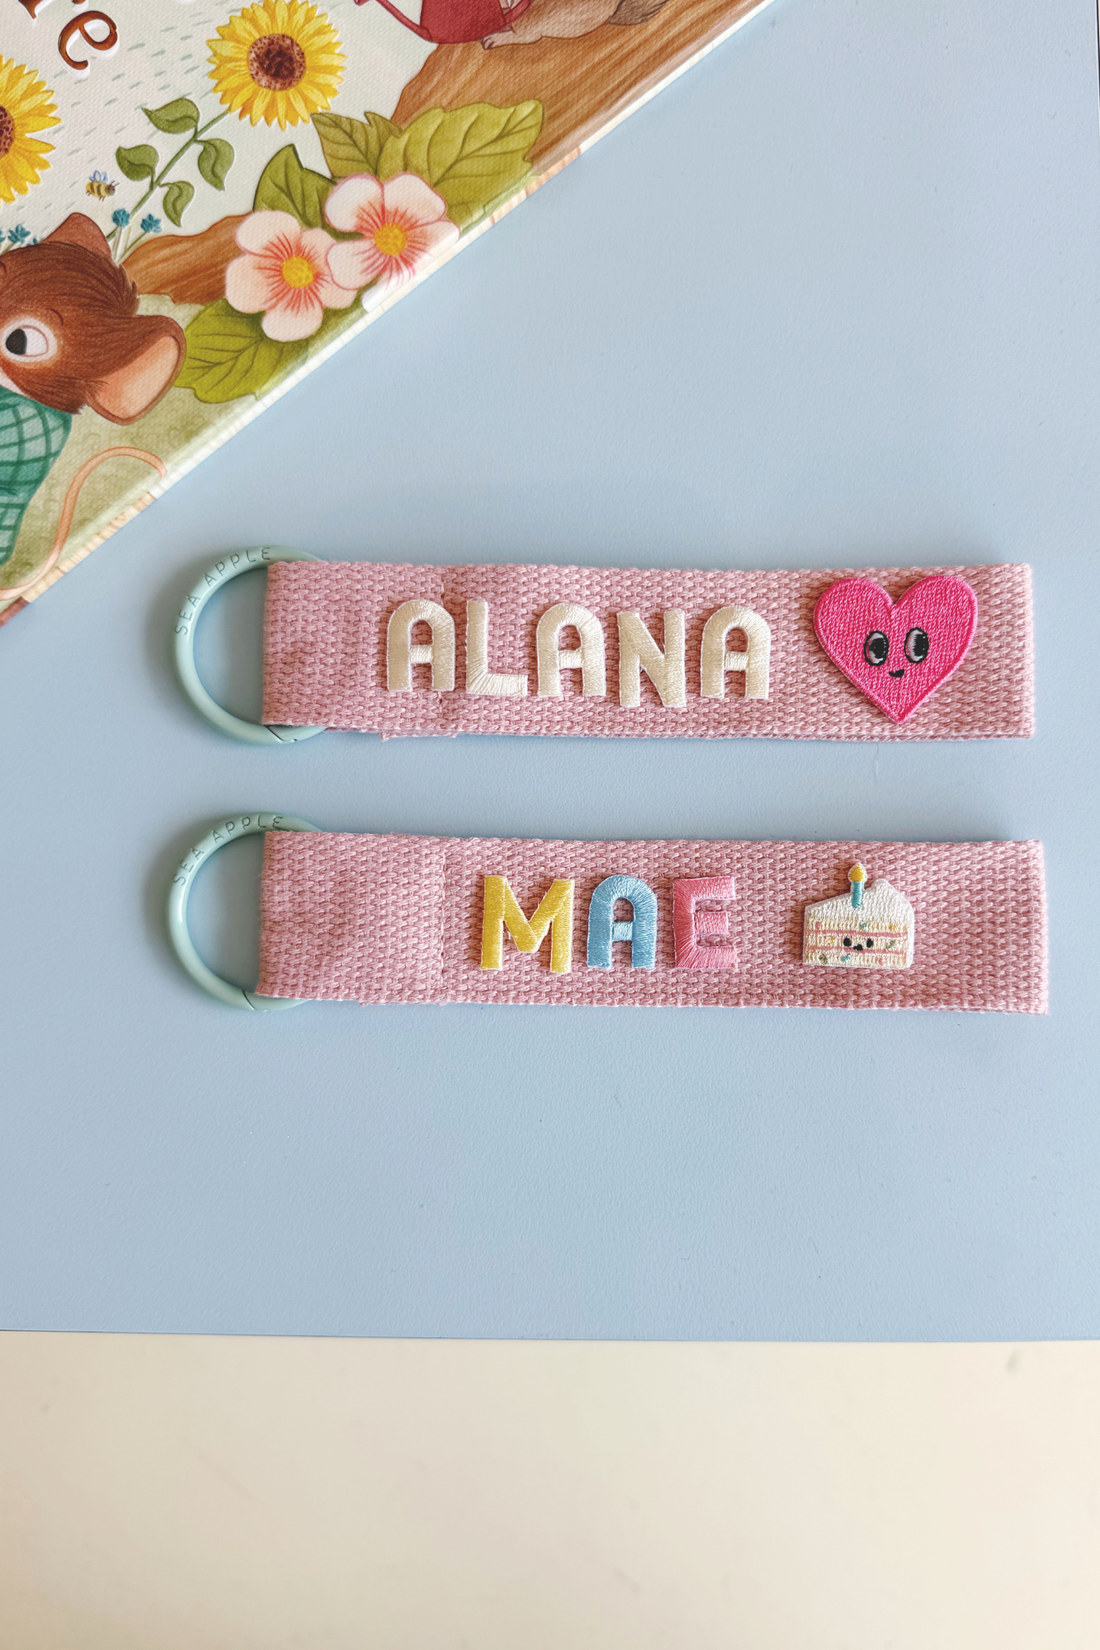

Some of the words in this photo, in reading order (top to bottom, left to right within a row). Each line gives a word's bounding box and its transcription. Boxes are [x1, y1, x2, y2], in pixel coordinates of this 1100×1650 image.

[174, 593, 201, 635] SEA
[204, 546, 271, 587] APPLE
[386, 599, 772, 708] ALANA
[173, 847, 205, 886] SEA
[212, 814, 284, 843] APPLE
[480, 874, 739, 973] MAE
